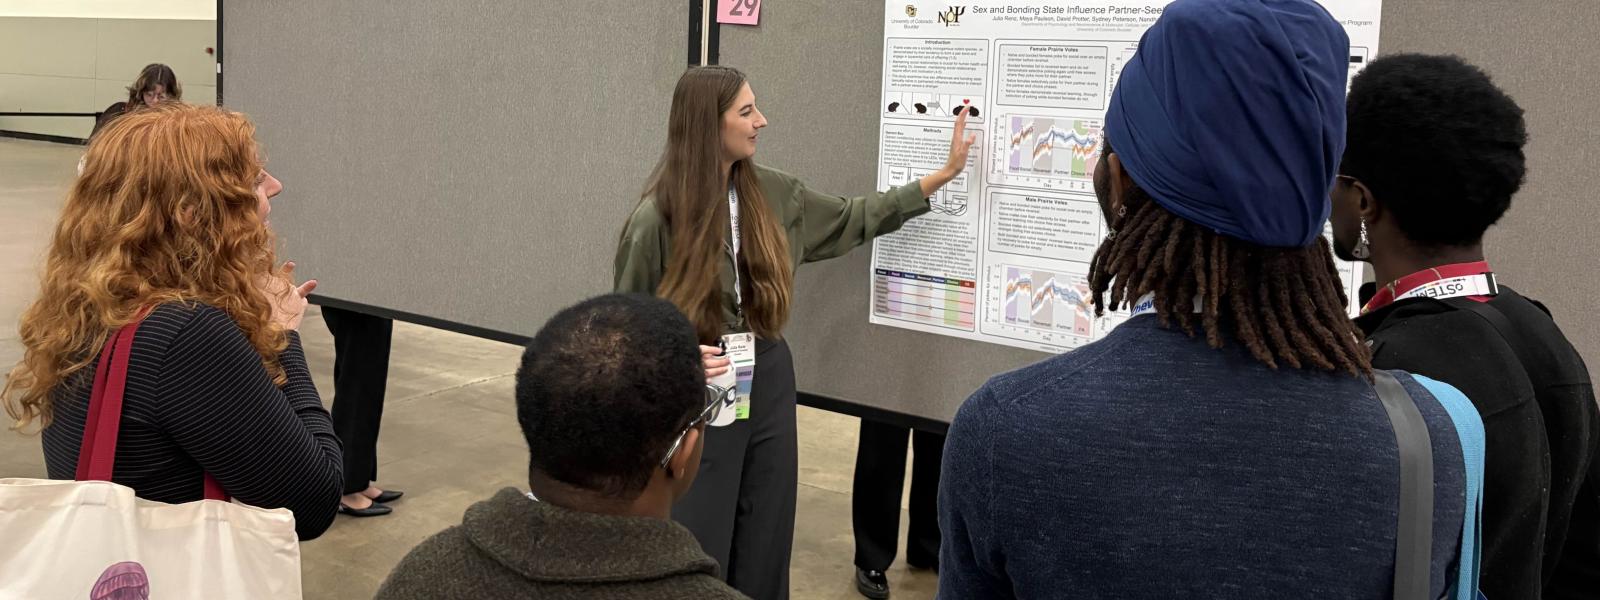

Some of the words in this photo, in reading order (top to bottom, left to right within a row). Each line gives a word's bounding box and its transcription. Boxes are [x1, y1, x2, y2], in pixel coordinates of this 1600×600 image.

[729, 0, 758, 16] 29
[972, 5, 988, 14] Sex
[990, 5, 1005, 14] and
[1007, 5, 1040, 15] Bonding
[1042, 5, 1065, 14] State
[1067, 5, 1106, 14] Influence
[1109, 5, 1164, 14] Partner-See
